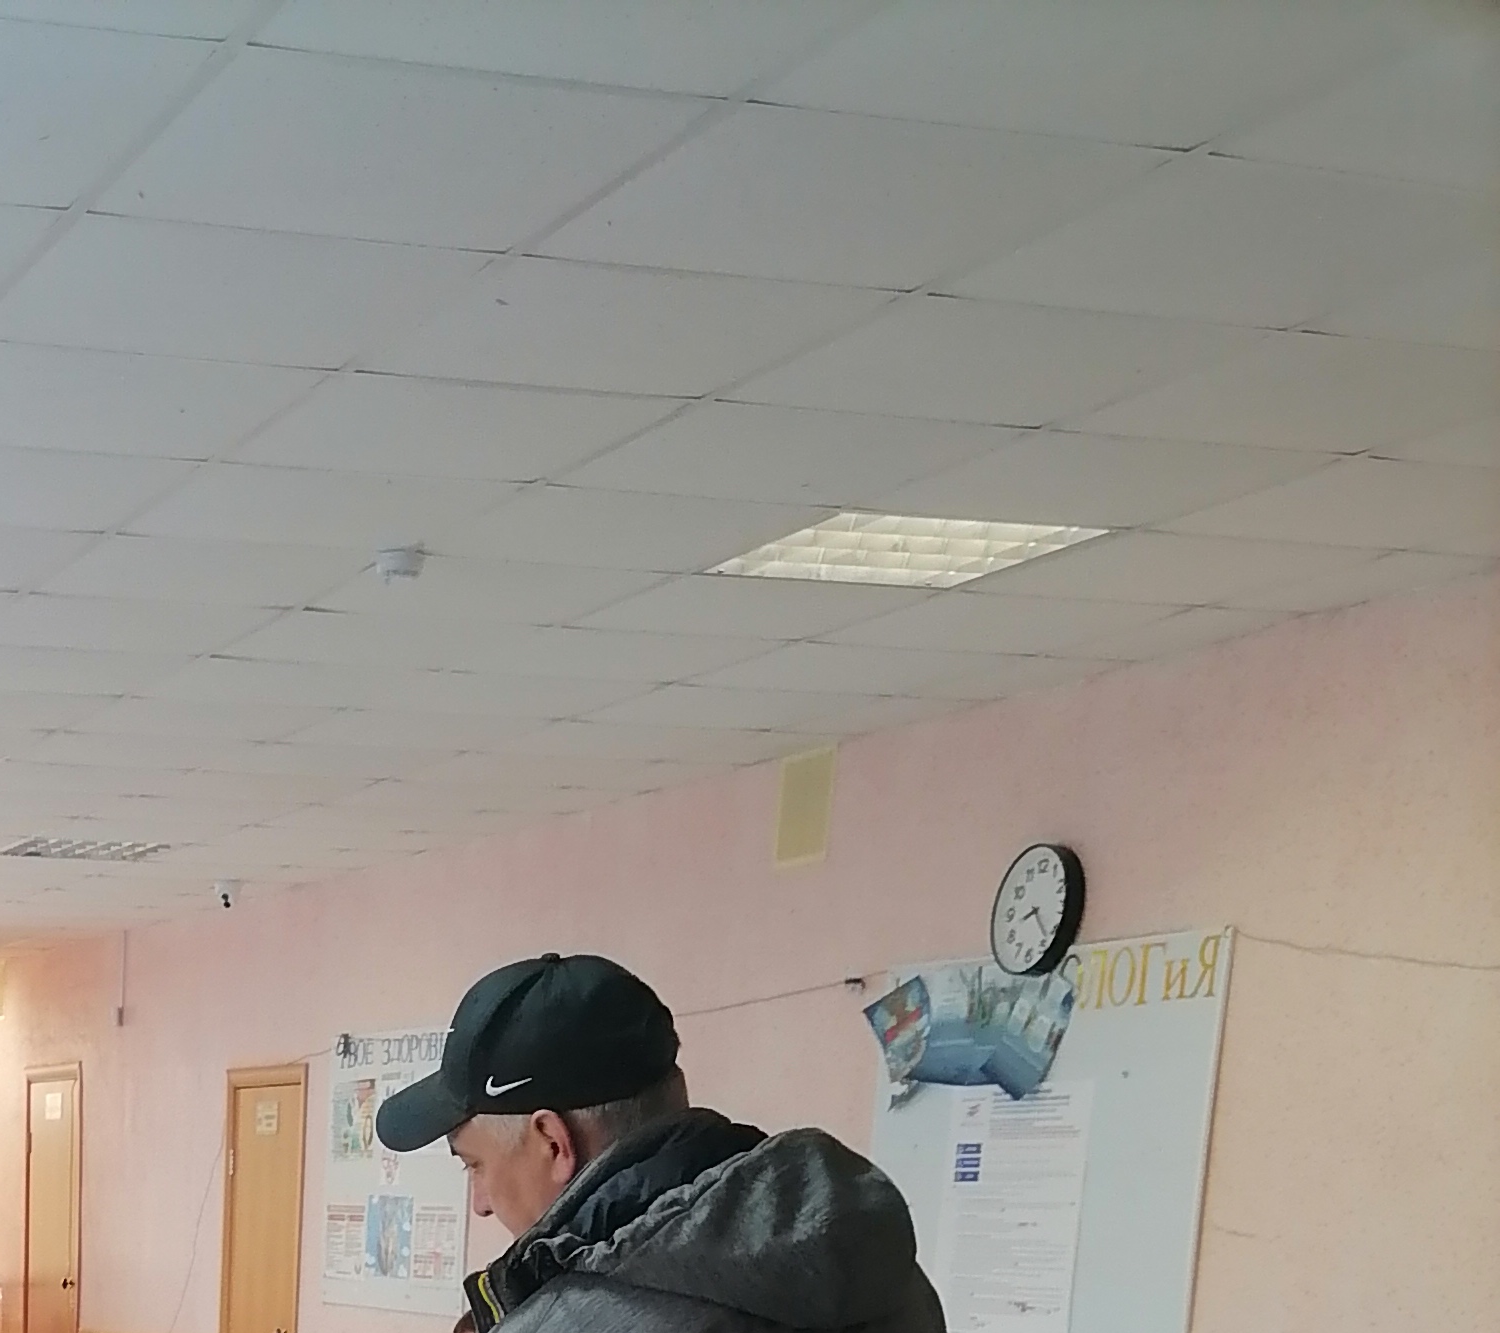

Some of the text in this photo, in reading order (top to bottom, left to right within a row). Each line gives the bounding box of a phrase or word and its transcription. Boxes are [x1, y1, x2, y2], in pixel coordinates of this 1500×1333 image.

[1037, 858, 1050, 874] 12
[1006, 906, 1016, 923] 9
[1006, 928, 1016, 945] 8
